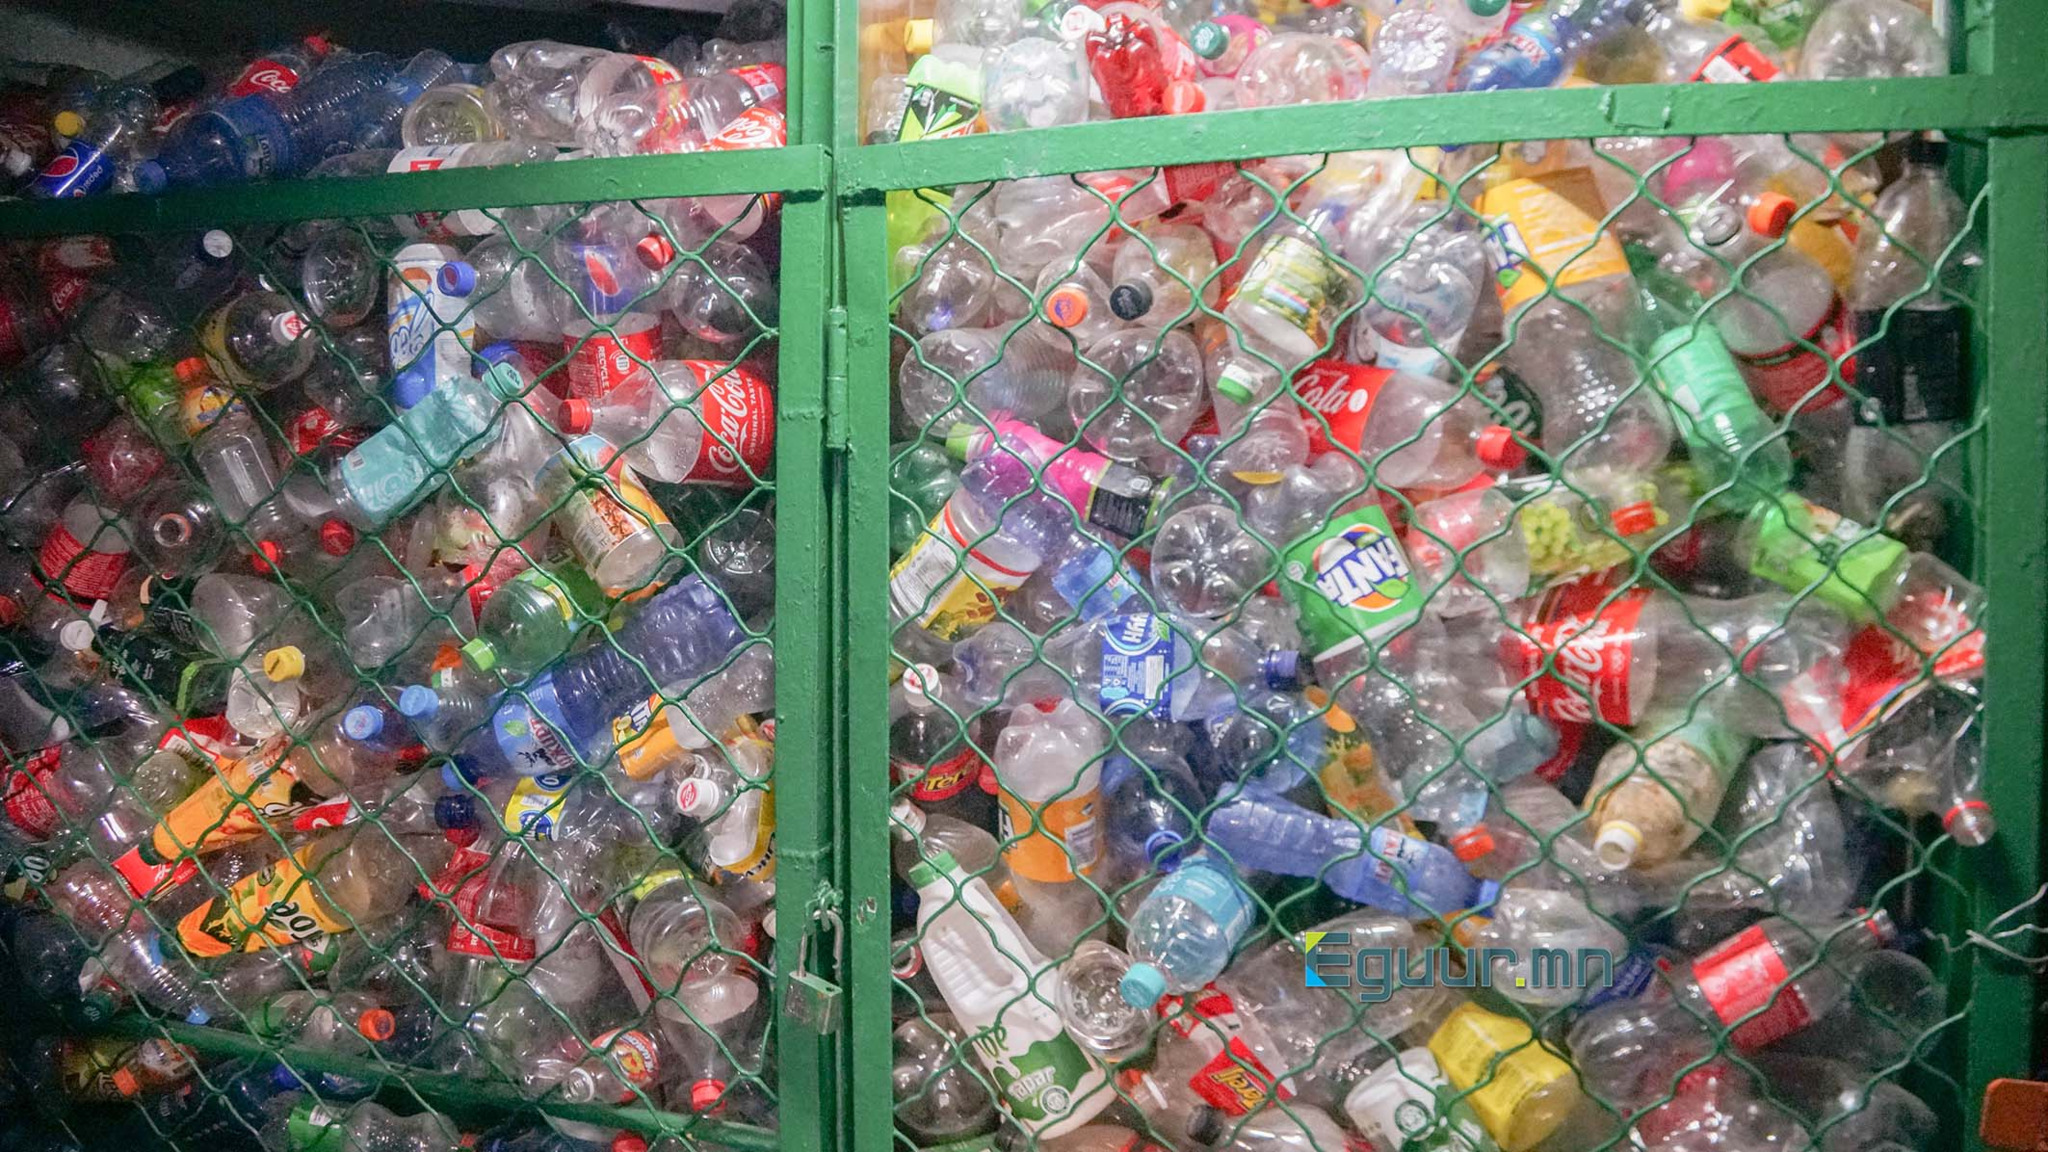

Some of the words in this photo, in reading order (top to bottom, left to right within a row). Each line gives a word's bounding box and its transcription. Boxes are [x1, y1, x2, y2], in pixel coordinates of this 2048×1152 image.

[597, 346, 609, 388] RECYCLE
[746, 377, 757, 404] TASTE
[749, 408, 759, 455] ORIGINAL
[1315, 537, 1410, 606] FANTA
